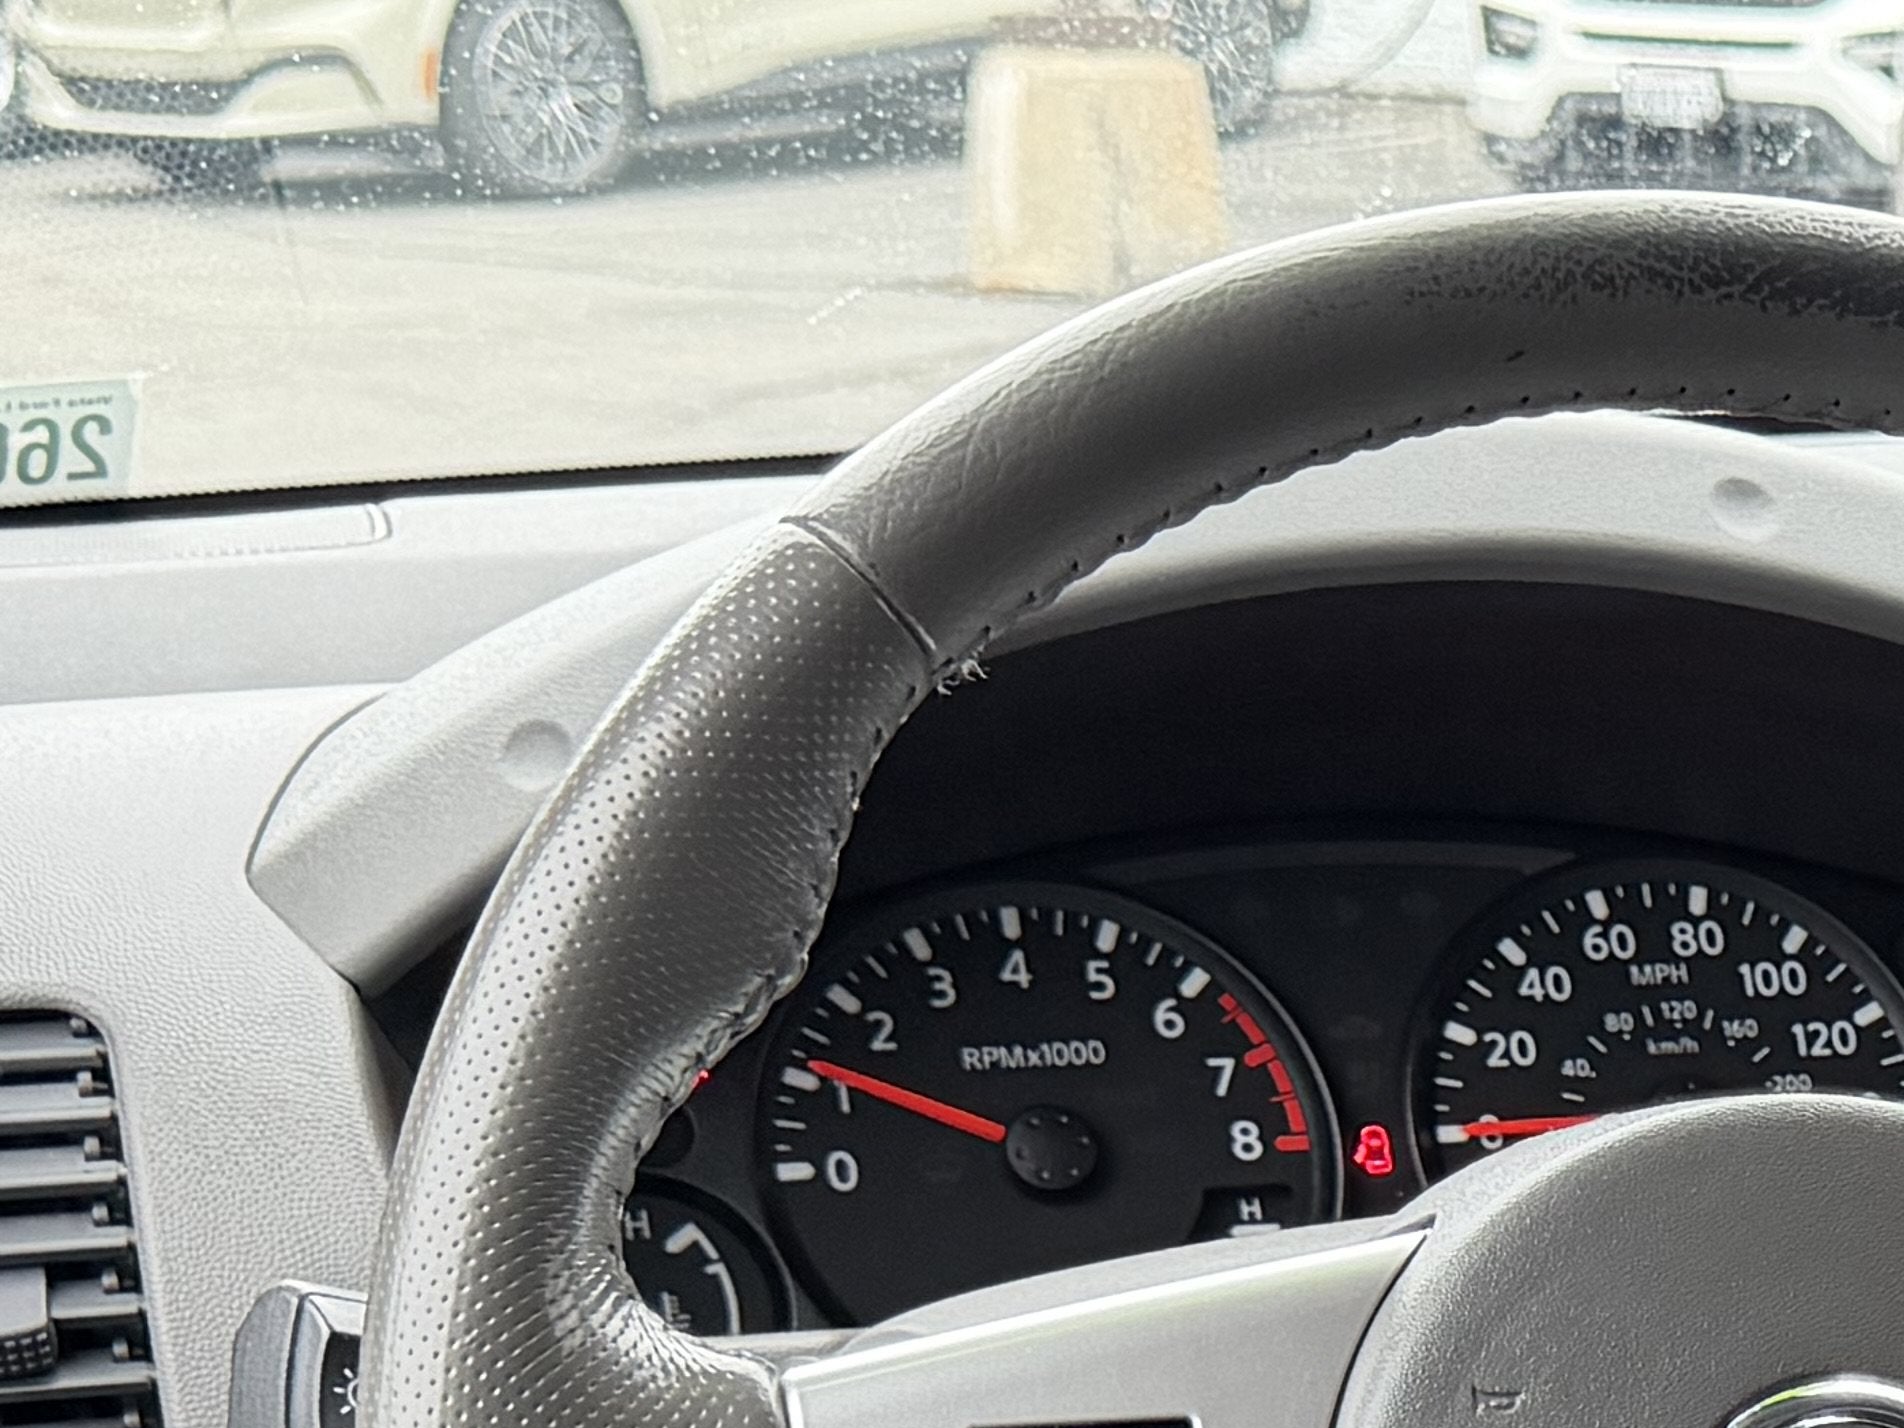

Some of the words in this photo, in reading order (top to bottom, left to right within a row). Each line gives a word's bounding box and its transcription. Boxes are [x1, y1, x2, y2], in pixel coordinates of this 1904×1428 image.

[1582, 923, 1637, 962] 60
[1669, 919, 1725, 958] 80
[926, 966, 958, 1009] 3
[998, 948, 1034, 990] 4
[1085, 959, 1117, 1001] 5
[1517, 964, 1573, 1002] 40
[1628, 961, 1690, 987] MPH
[1737, 959, 1808, 998] 100
[1153, 998, 1186, 1039] 6
[1603, 1011, 1635, 1034] 80
[1659, 999, 1698, 1021] 120
[1721, 1017, 1760, 1039] 160
[863, 1010, 899, 1051] 2
[1483, 1030, 1537, 1068] 20
[1790, 1019, 1859, 1058] 120
[960, 1039, 1107, 1071] RPMx1000
[1205, 1057, 1236, 1098] 7
[1229, 1119, 1264, 1162] 8
[826, 1149, 860, 1192] 0
[624, 1208, 651, 1241] H
[1239, 1197, 1263, 1221] H
